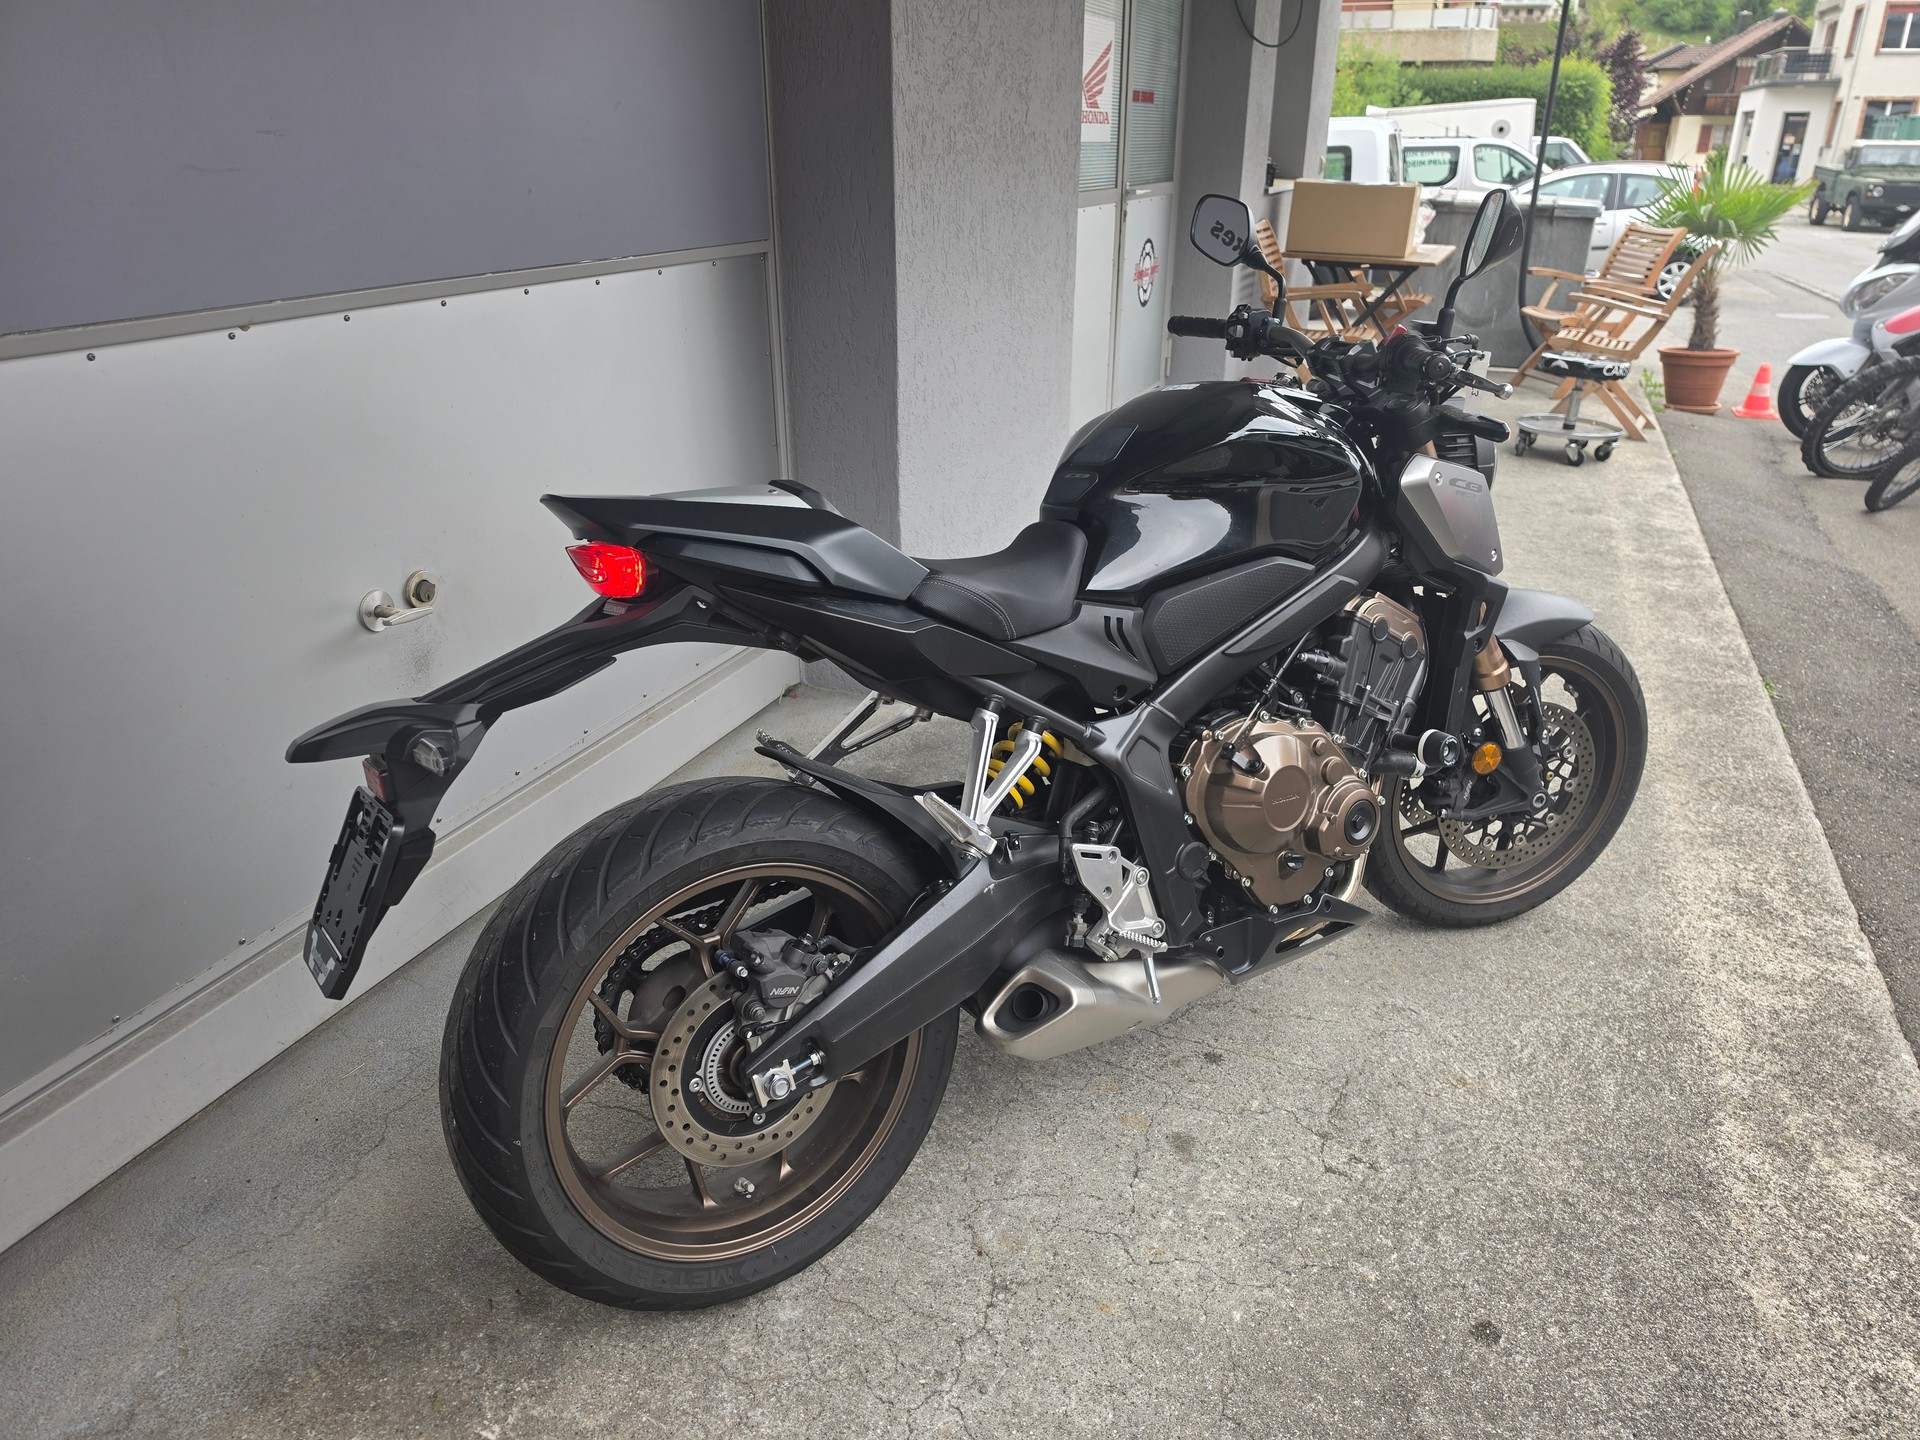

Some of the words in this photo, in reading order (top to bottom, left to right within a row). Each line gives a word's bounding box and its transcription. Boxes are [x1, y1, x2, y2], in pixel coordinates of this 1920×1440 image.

[1081, 110, 1110, 124] HONDA
[1449, 477, 1483, 493] CB
[769, 986, 800, 996] NISSIN
[585, 1242, 734, 1288] METZELER
